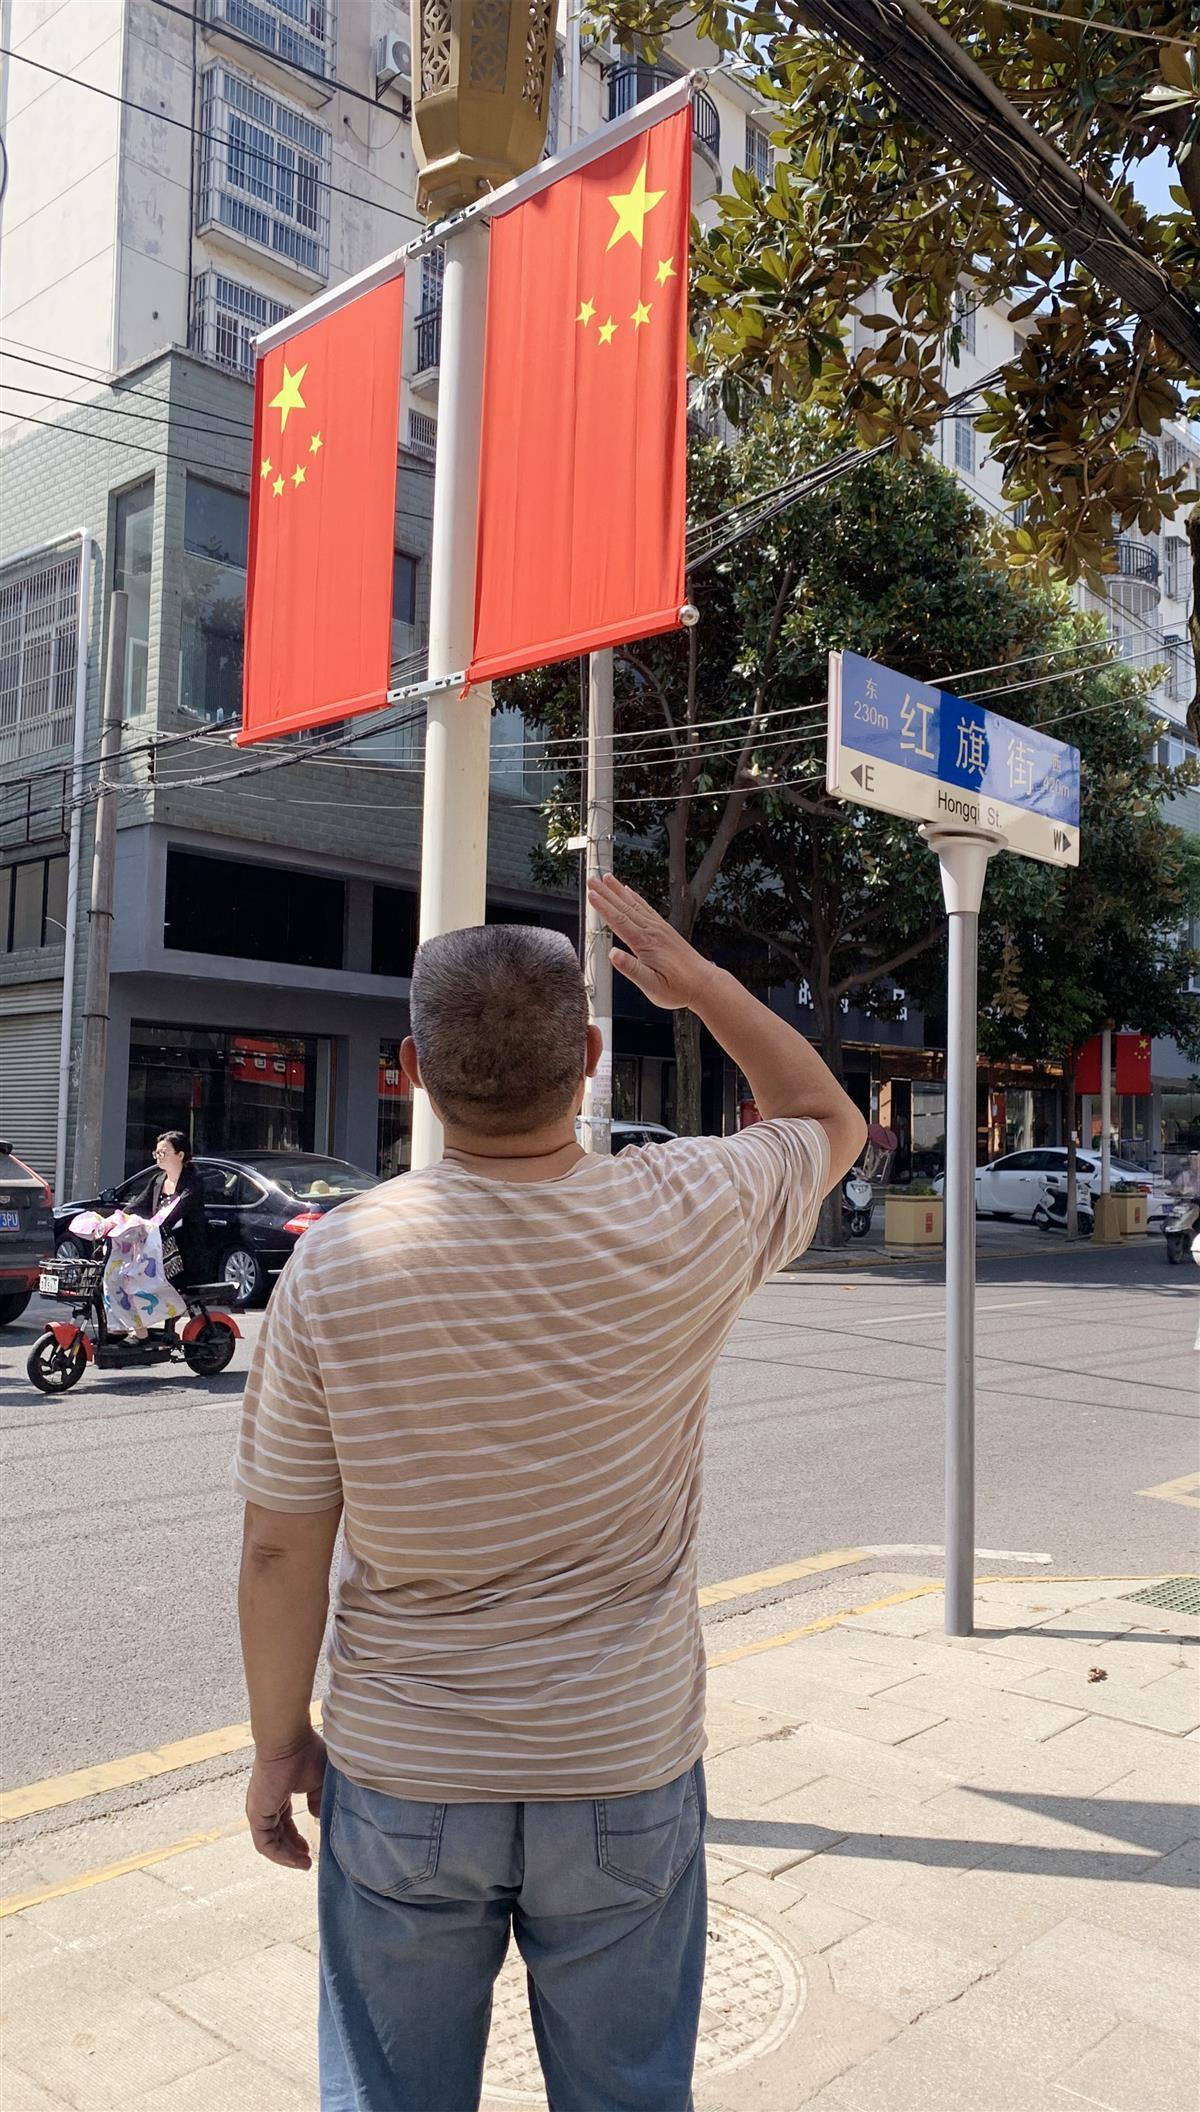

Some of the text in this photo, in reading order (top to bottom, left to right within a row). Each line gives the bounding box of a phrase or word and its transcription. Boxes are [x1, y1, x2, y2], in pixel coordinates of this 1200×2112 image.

[865, 677, 879, 700] 东
[853, 700, 889, 730] 230m
[899, 692, 1036, 796] 红旗街
[864, 764, 875, 793] E
[937, 789, 1002, 829] Hongqi St.
[1053, 828, 1063, 852] W
